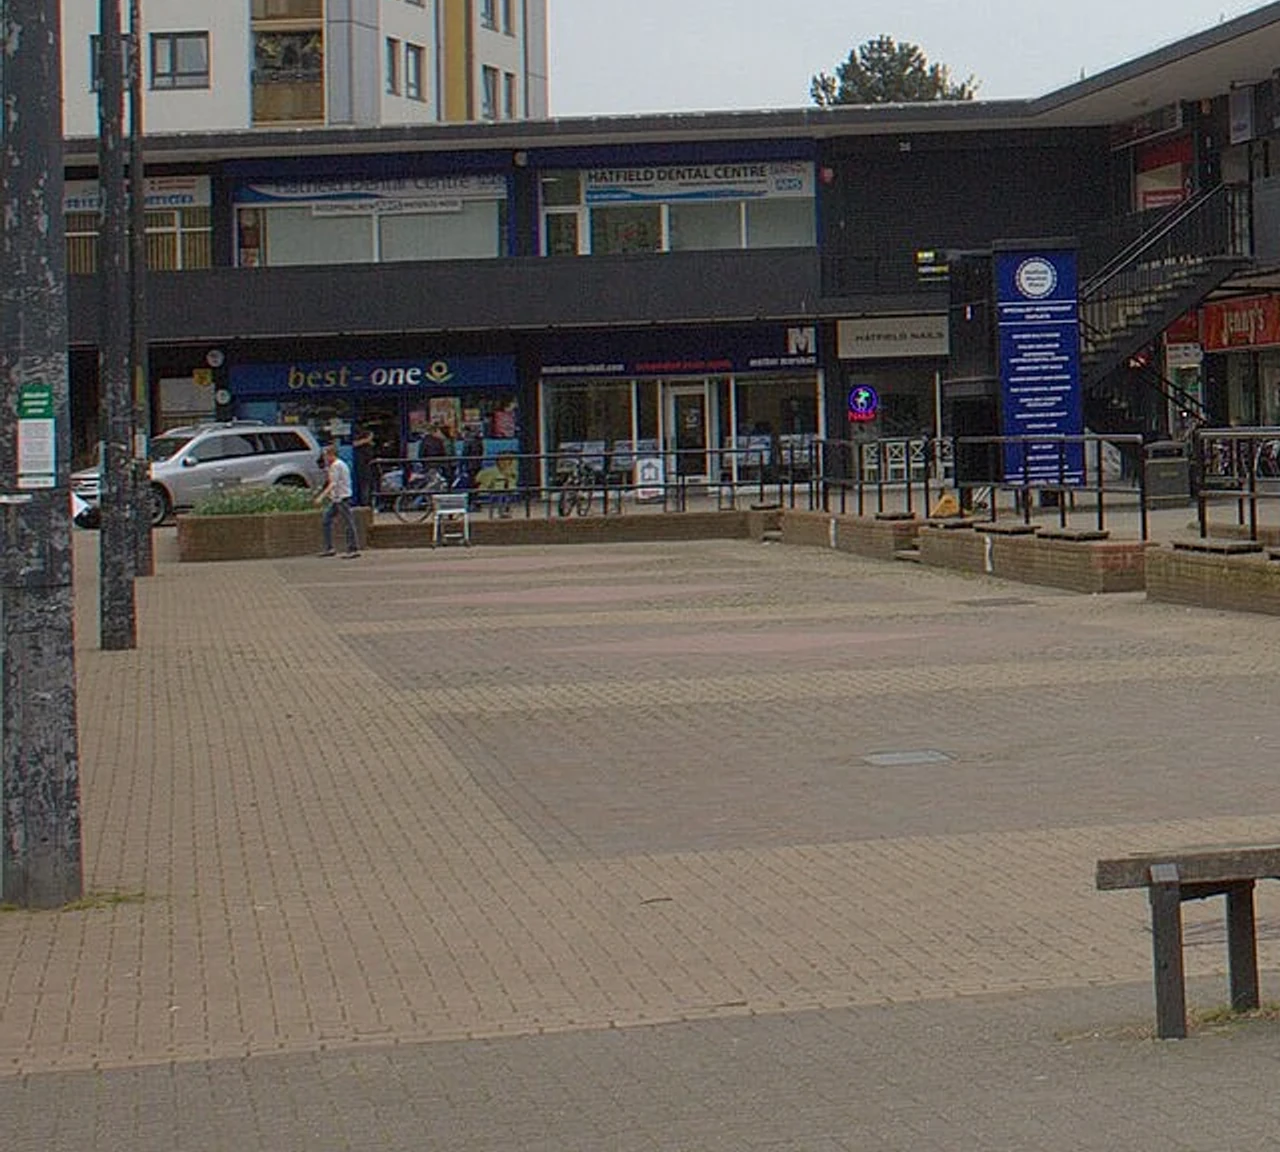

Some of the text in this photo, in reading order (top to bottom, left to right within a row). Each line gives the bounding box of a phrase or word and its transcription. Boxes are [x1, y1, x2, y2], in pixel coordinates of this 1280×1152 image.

[588, 169, 655, 182] HATFIELD
[657, 168, 709, 181] DENTAL
[714, 165, 767, 179] CENTRE
[856, 333, 906, 342] HATFIELD
